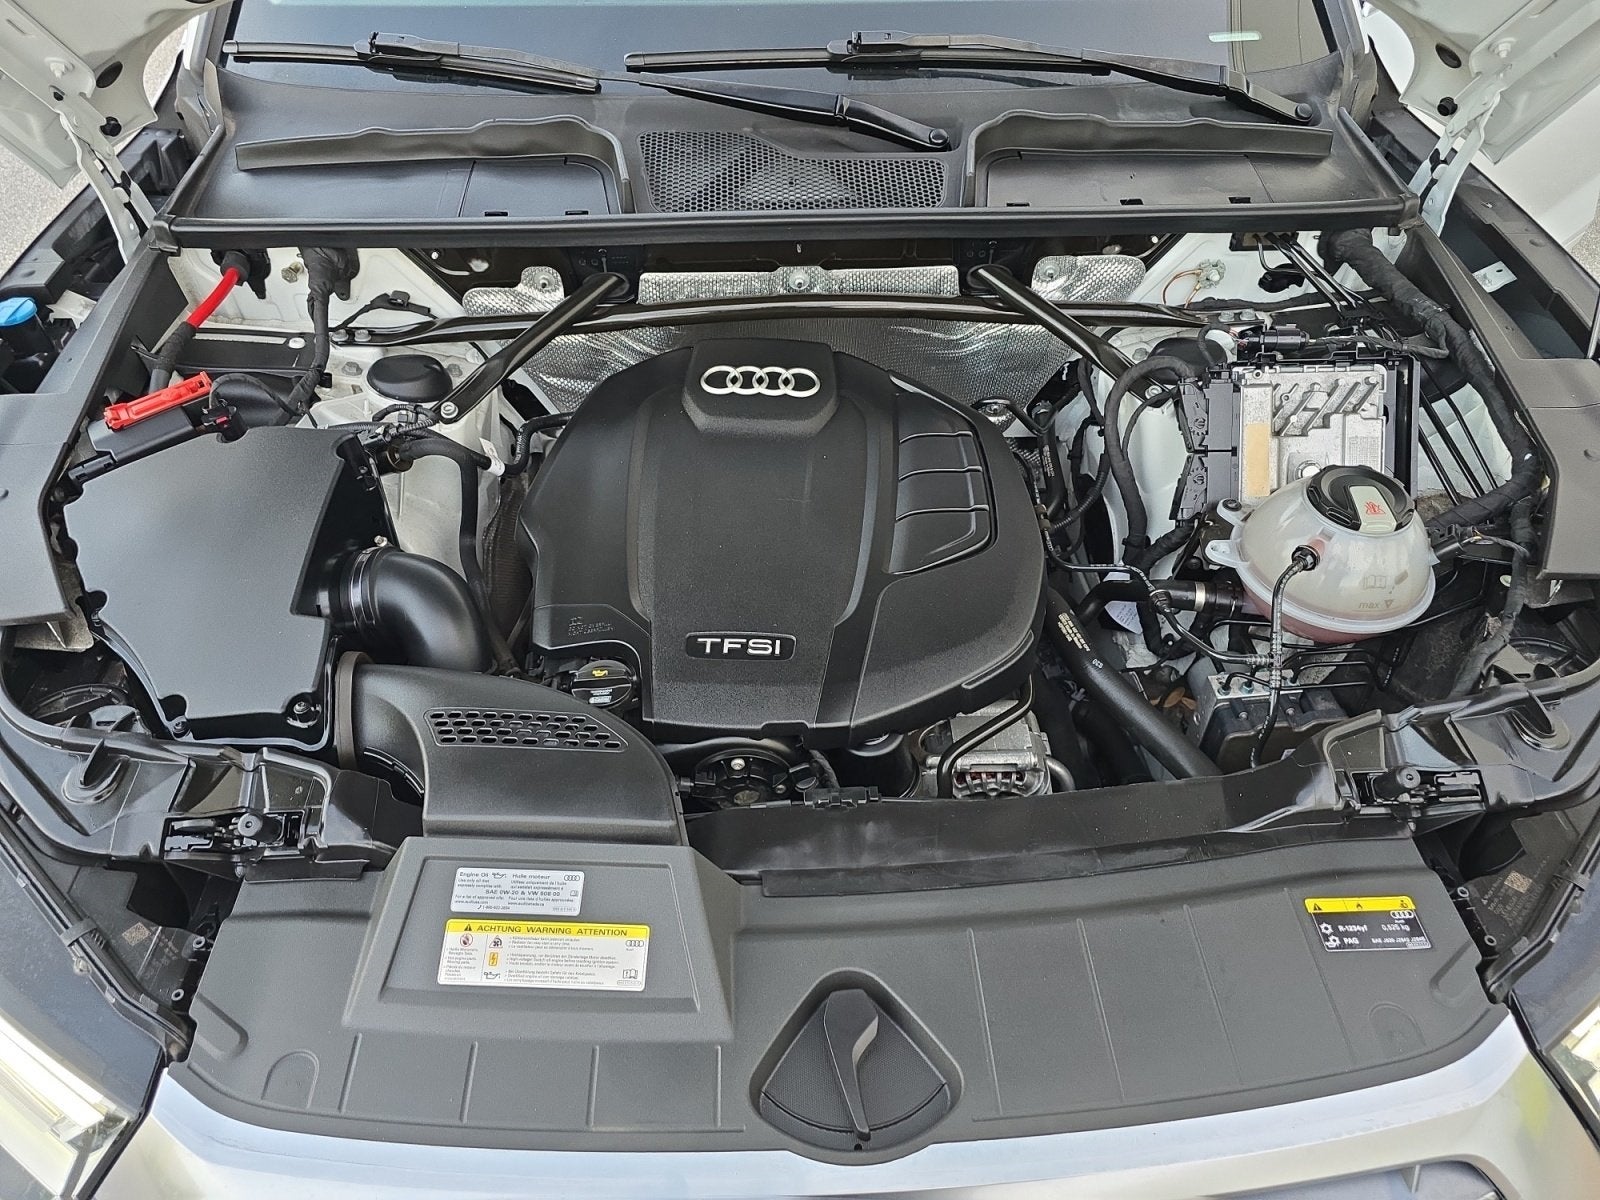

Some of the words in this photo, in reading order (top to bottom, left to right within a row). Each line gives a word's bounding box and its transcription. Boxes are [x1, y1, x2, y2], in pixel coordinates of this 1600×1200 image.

[696, 637, 781, 656] TFSI
[476, 925, 521, 933] ACHTUNG
[526, 926, 572, 934] WARNING
[576, 928, 628, 936] ATTENTION
[1338, 924, 1368, 933] R-1234yf
